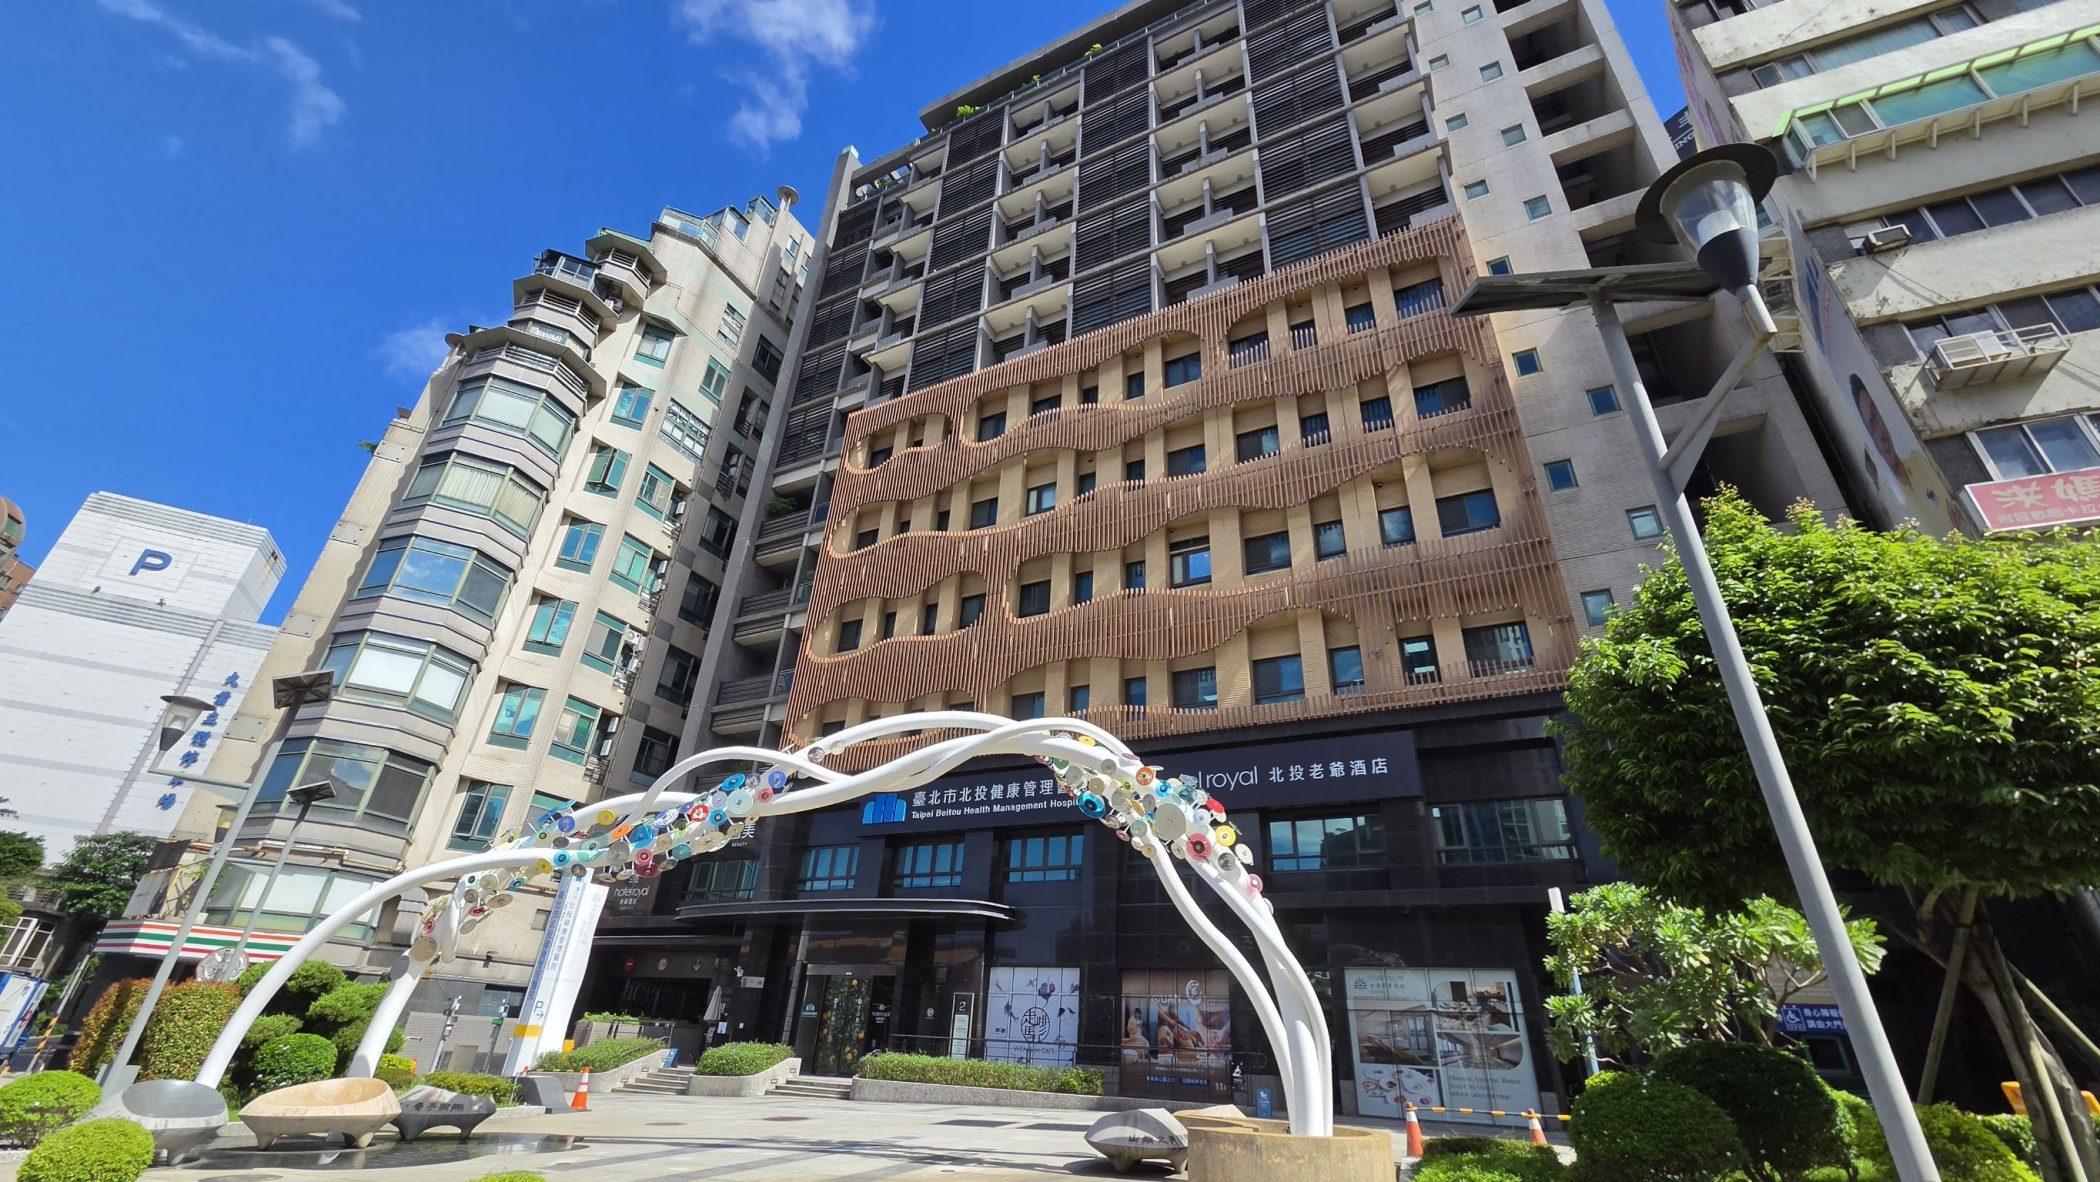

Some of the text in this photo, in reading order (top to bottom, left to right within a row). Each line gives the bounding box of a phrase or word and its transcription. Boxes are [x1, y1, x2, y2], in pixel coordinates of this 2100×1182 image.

[1997, 504, 2100, 525] 附設歌唱卡拉
[128, 548, 173, 576] P
[1206, 765, 1259, 791] royal
[1268, 757, 1389, 783] 北投老爺酒店
[912, 779, 1070, 807] 臺北市北投健康管理醫
[911, 808, 934, 819] Taipei
[935, 806, 962, 817] Beitou
[963, 804, 991, 815] Health
[992, 800, 1048, 813] Management
[959, 1001, 967, 1012] 2
[1803, 1007, 1843, 1018] 身心障礙
